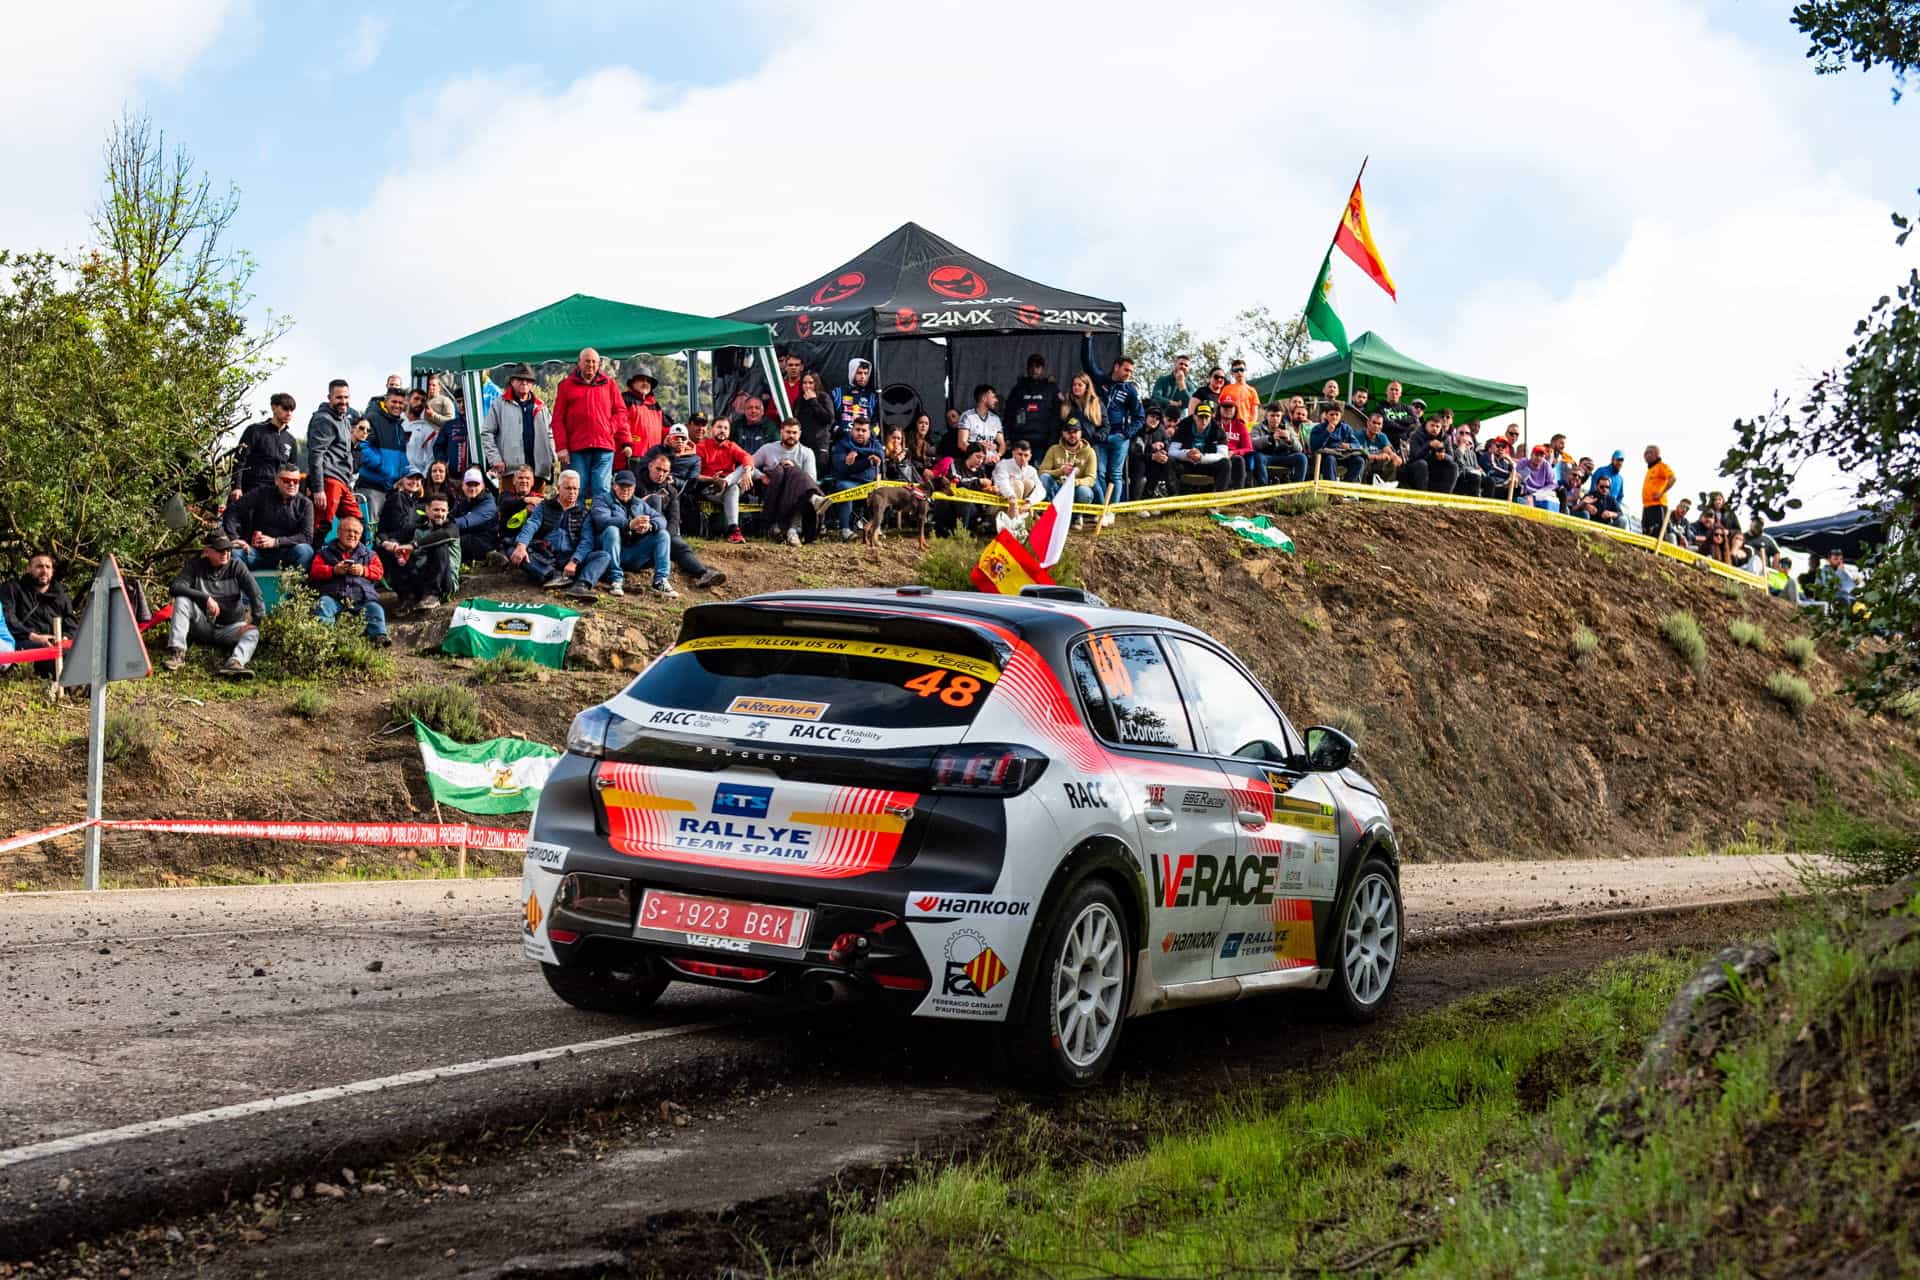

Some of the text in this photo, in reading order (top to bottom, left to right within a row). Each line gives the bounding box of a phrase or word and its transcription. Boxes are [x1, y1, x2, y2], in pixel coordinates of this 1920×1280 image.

[921, 309, 994, 328] 24MX
[1043, 309, 1111, 326] 24MX
[812, 321, 862, 336] 24MX
[805, 640, 825, 648] US
[826, 642, 849, 650] ON
[904, 669, 981, 707] 48
[650, 711, 696, 726] RACC
[790, 724, 883, 742] RACC Mobility
[841, 735, 862, 745] Club
[696, 746, 798, 763] PEUGEOT
[717, 792, 768, 809] RTS
[487, 830, 504, 848] ZONA
[679, 817, 812, 845] RALLYE
[675, 836, 809, 860] TEAM SPAIN
[676, 902, 730, 930] 1923
[1244, 930, 1289, 945] RALLYE
